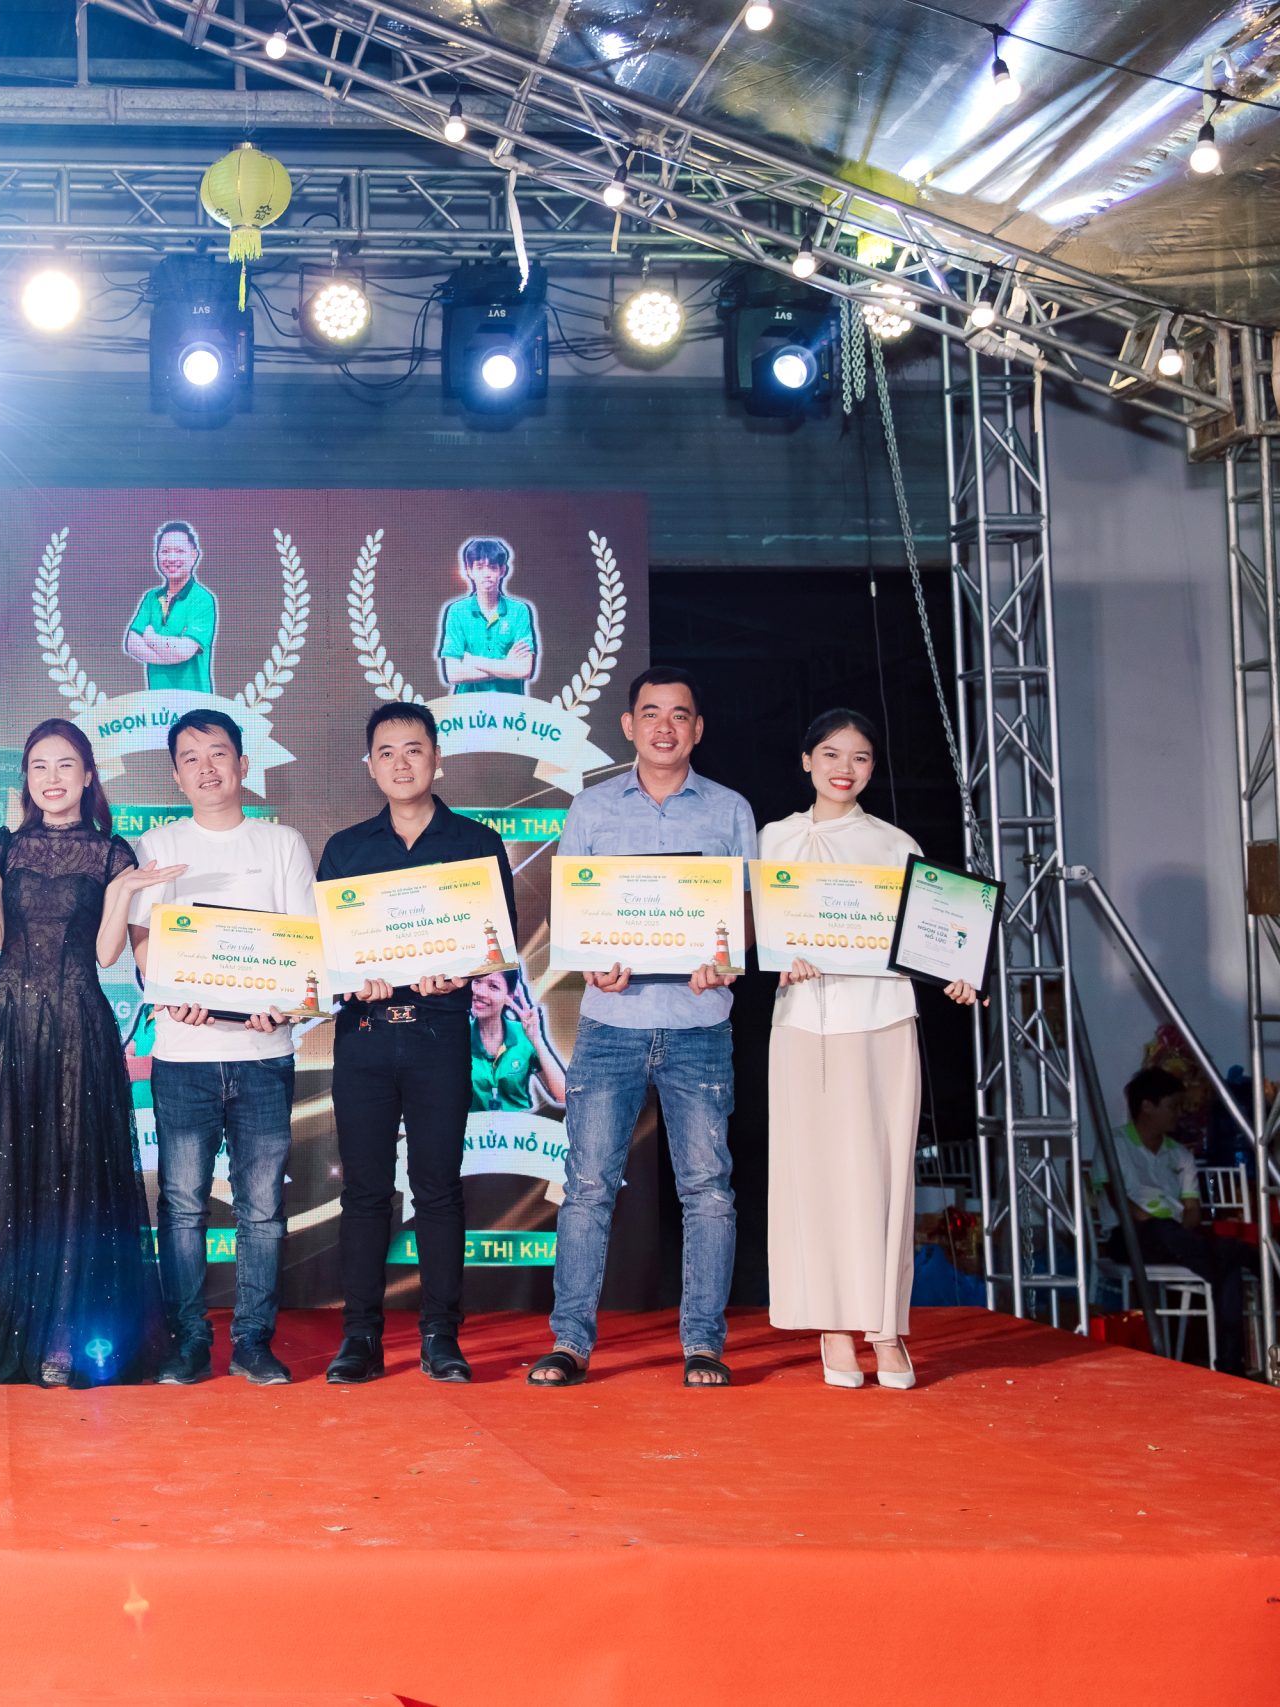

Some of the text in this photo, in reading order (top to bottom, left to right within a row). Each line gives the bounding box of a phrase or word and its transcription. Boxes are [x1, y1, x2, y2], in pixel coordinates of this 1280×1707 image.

[98, 715, 147, 738] NGỌN
[469, 710, 497, 729] LỬA
[503, 712, 527, 732] NỖ
[531, 721, 562, 742] LỰC
[617, 909, 646, 919] NGỌN
[385, 921, 414, 932] NGỌN
[580, 931, 686, 946] 24.000.000
[786, 932, 889, 950] 24.000.000
[212, 954, 240, 963] NGỌN
[354, 937, 457, 965] 24.000.000
[174, 971, 277, 990] 24.000.000
[479, 1129, 508, 1149] LỬA
[514, 1131, 538, 1152] NỖ
[480, 1240, 513, 1262] THỊ
